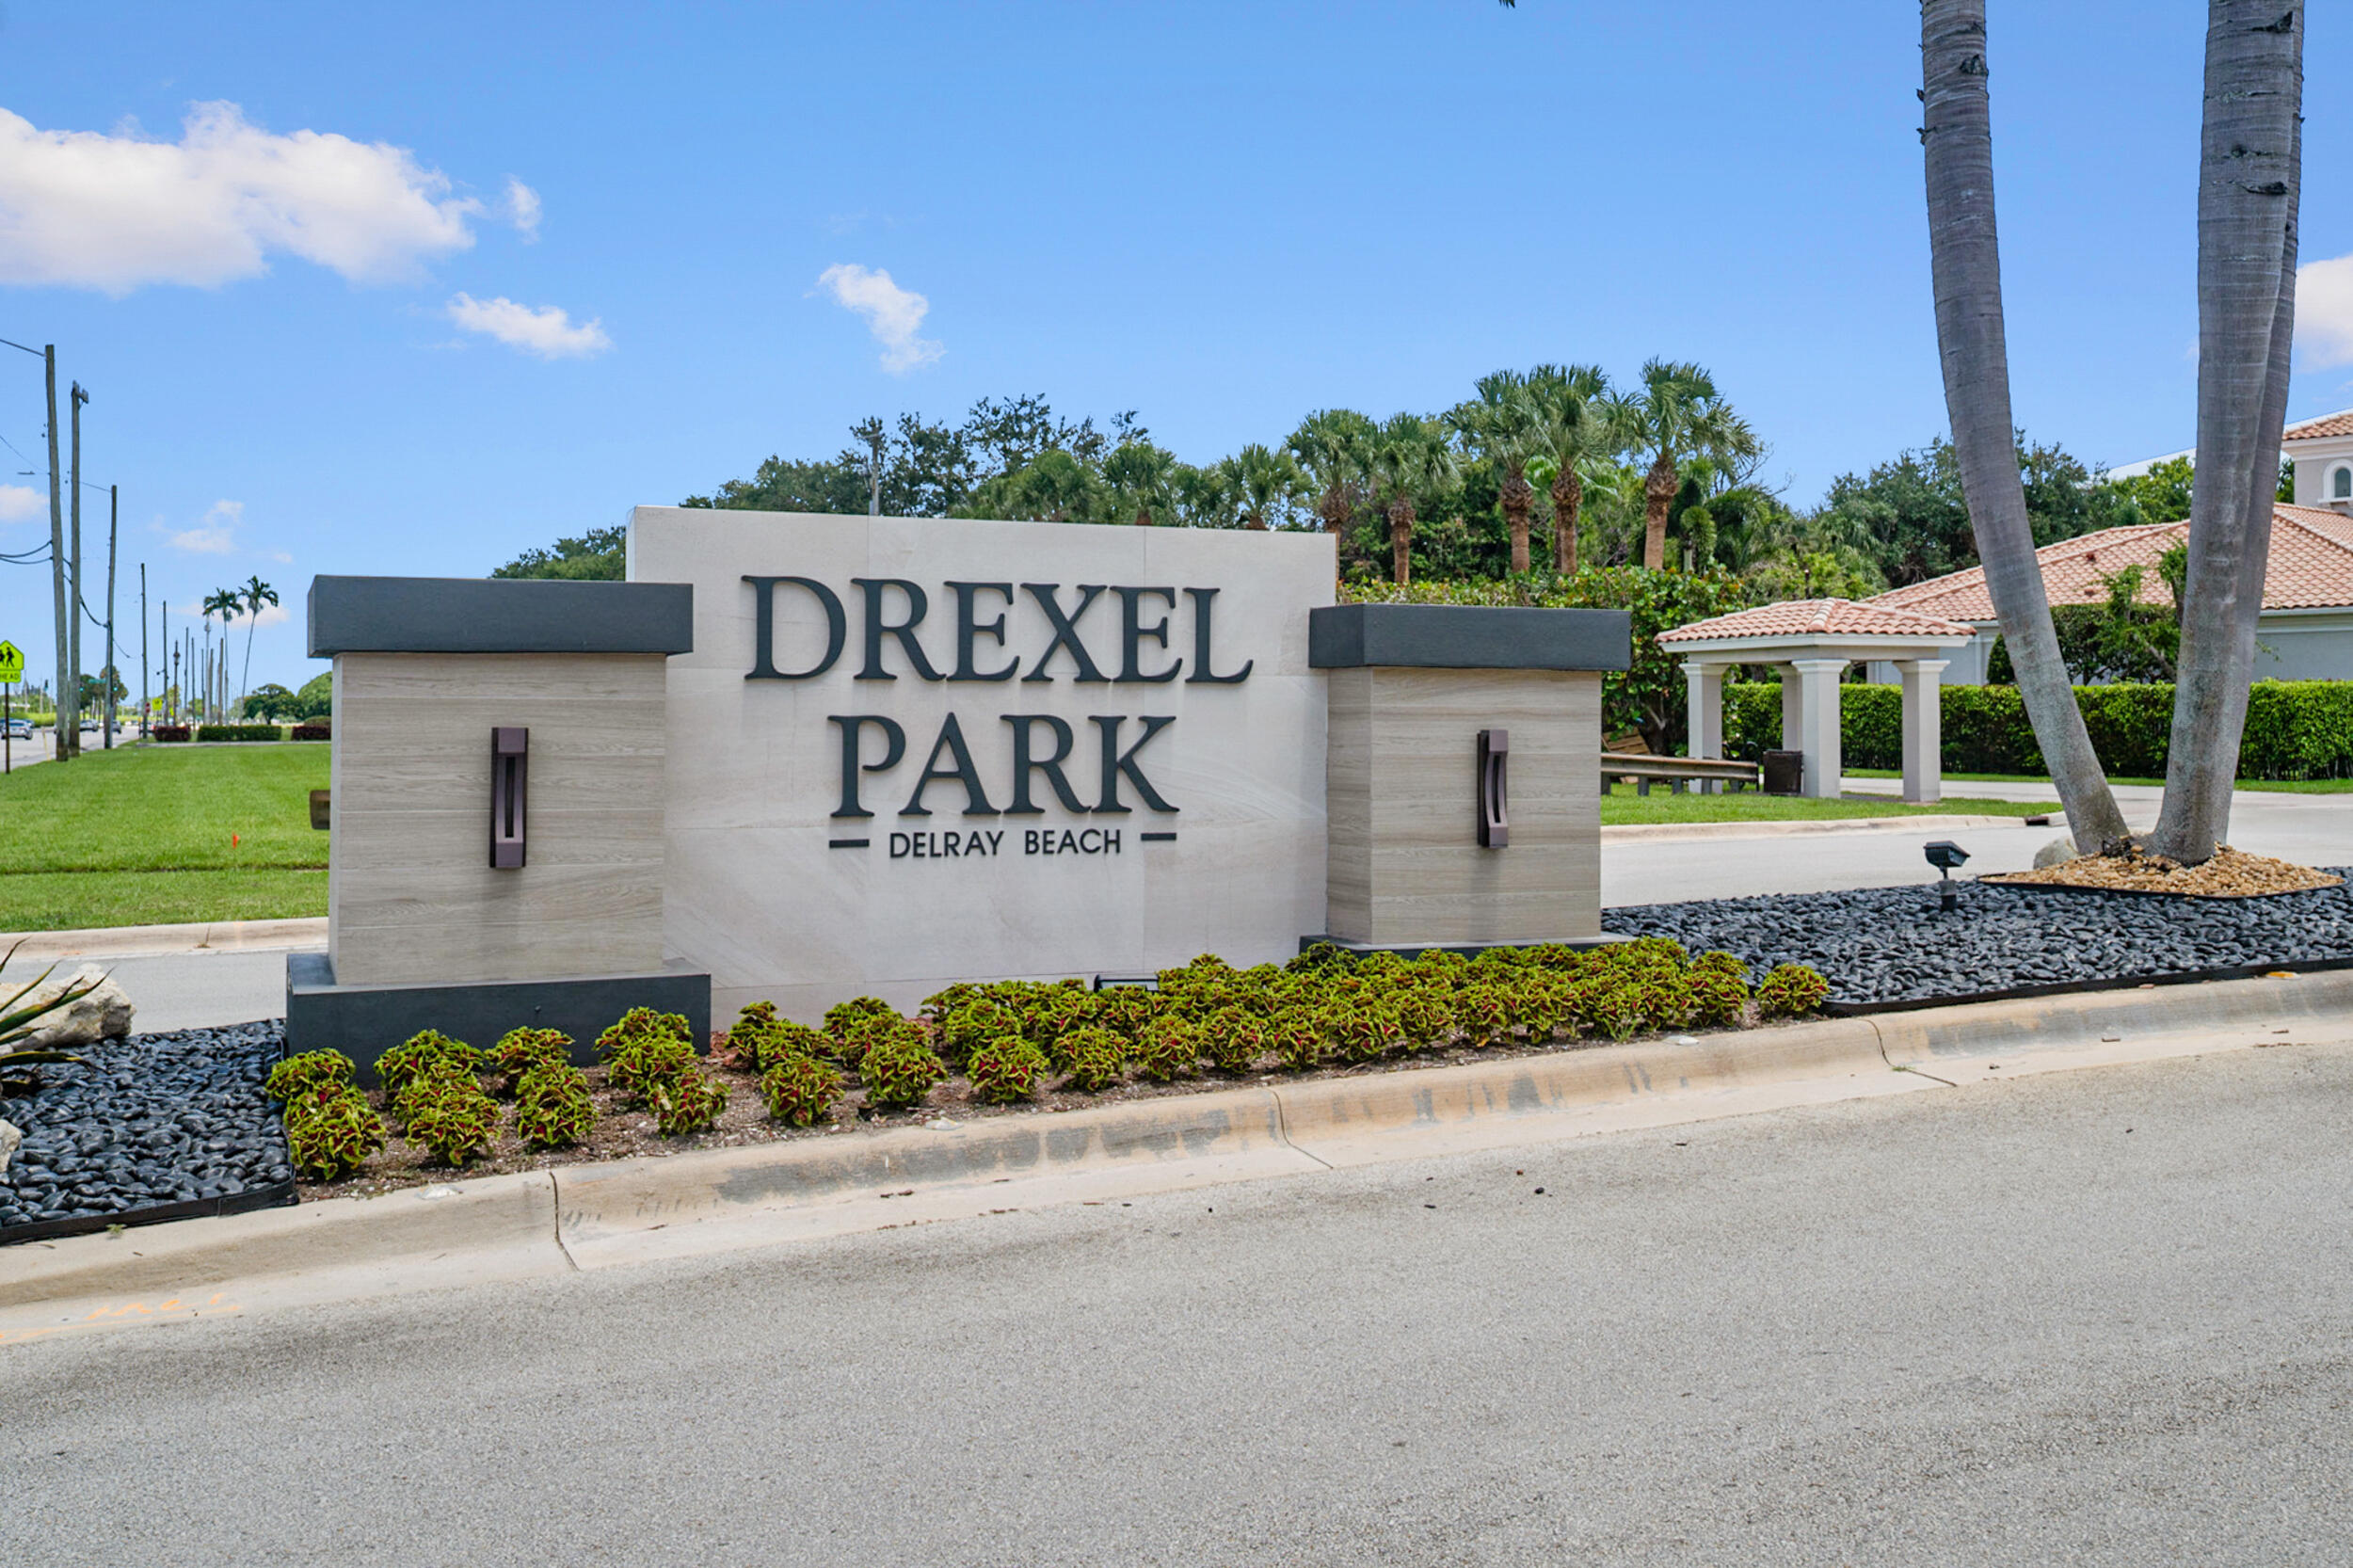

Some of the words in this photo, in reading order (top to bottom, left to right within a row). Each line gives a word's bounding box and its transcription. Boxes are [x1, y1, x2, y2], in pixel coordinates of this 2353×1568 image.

[741, 574, 1254, 684] DREXEL
[827, 712, 1179, 819] PARK
[890, 831, 1004, 858] DELRAY
[1024, 829, 1121, 855] BEACH
